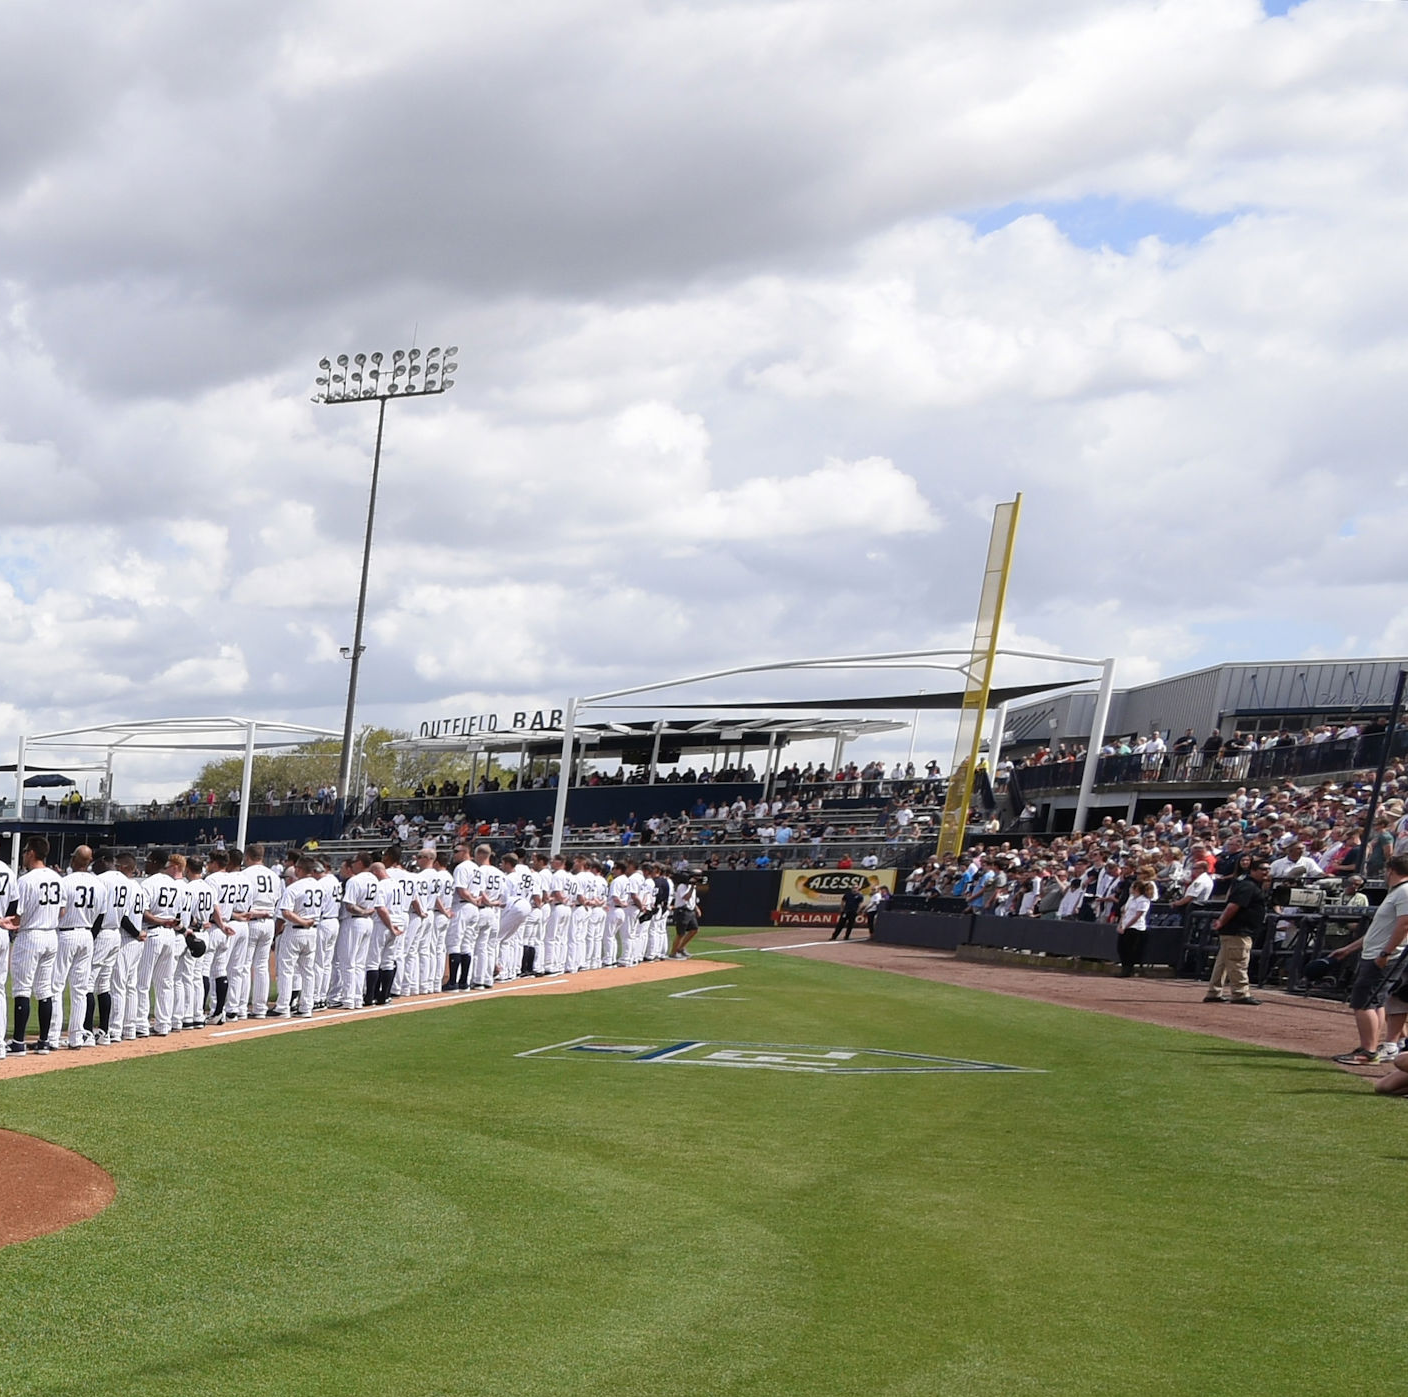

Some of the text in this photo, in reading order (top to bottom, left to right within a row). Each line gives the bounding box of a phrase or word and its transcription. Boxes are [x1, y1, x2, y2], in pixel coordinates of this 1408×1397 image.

[420, 709, 563, 737] OUTFIELD BAR
[256, 875, 274, 893] 91
[365, 883, 378, 901] 12
[486, 875, 501, 890] 95
[809, 876, 866, 890] ALESSI
[39, 881, 61, 905] 33
[74, 886, 95, 909] 31
[113, 885, 128, 908] 18
[158, 886, 178, 908] 67
[198, 891, 212, 912] 80
[219, 884, 236, 904] 72
[303, 889, 323, 908] 33
[392, 888, 401, 906] 11
[780, 913, 832, 923] ITALIAN
